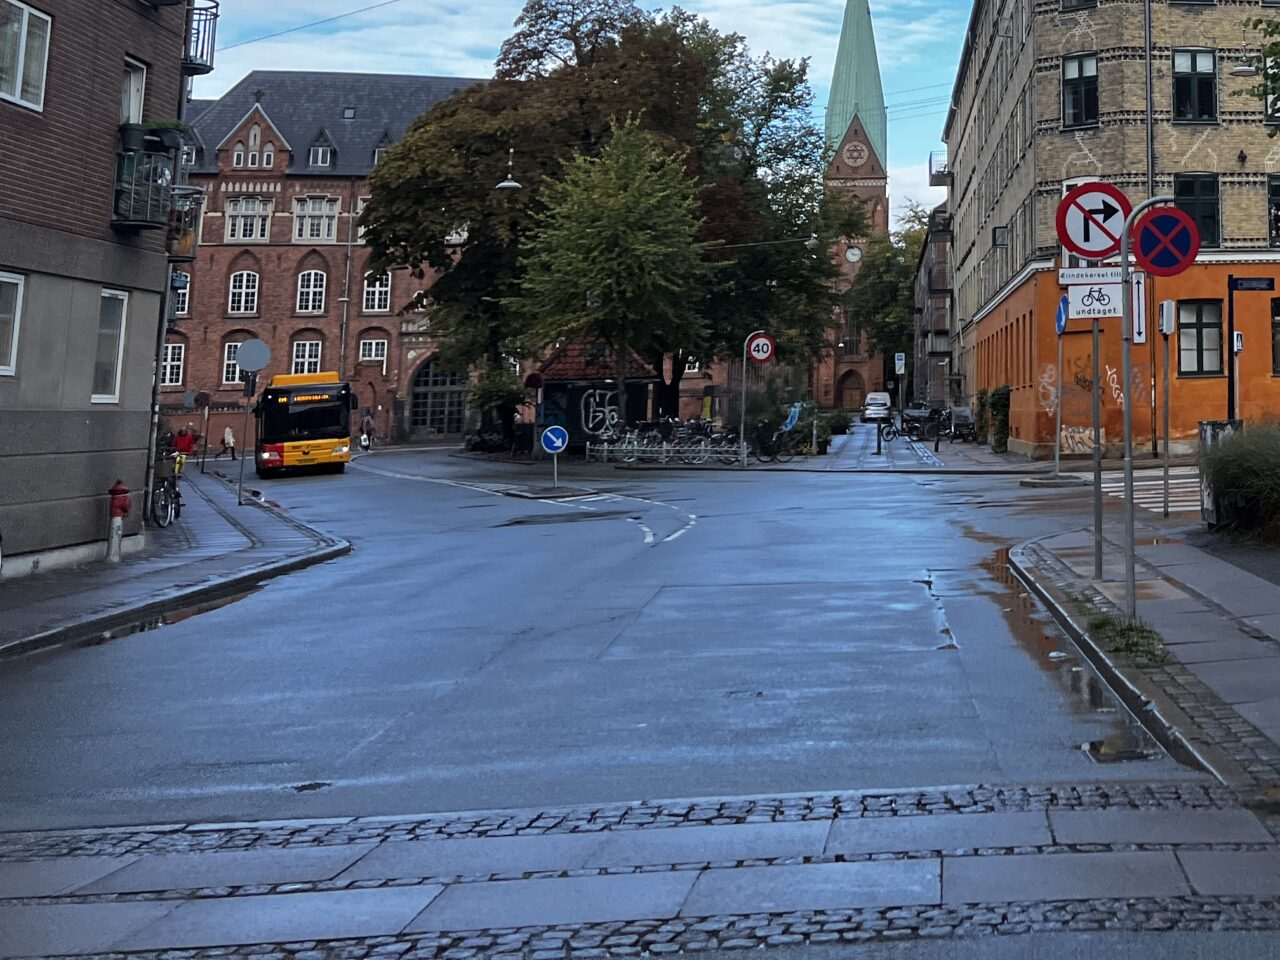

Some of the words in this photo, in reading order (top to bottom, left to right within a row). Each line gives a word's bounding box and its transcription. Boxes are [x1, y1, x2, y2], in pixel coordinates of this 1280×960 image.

[1076, 307, 1117, 315] undtaget
[753, 343, 769, 353] 40
[1105, 365, 1125, 411] YOGA
